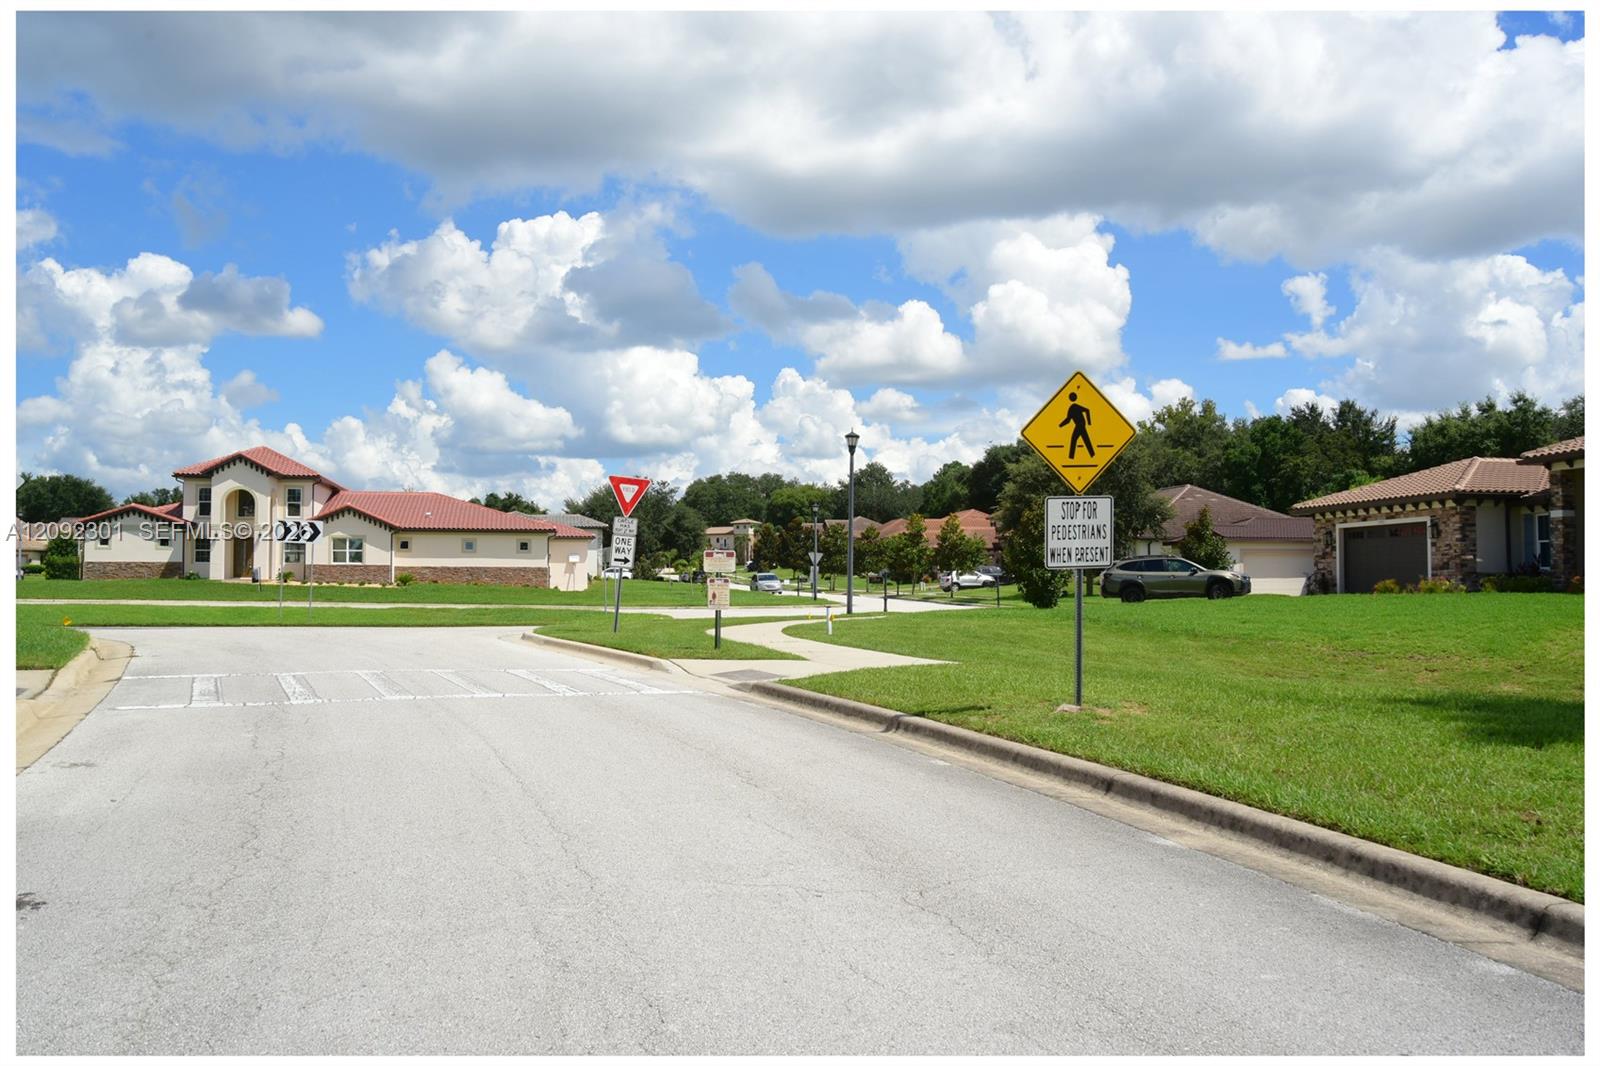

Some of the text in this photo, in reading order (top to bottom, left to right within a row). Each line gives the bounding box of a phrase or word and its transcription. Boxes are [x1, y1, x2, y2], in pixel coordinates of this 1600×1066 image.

[1061, 501, 1098, 520] STOP FOR
[1051, 523, 1107, 541] PEDESTRIANS
[615, 537, 633, 546] ONE
[614, 546, 632, 555] WAY
[1050, 546, 1109, 563] WHEN PRESENT
